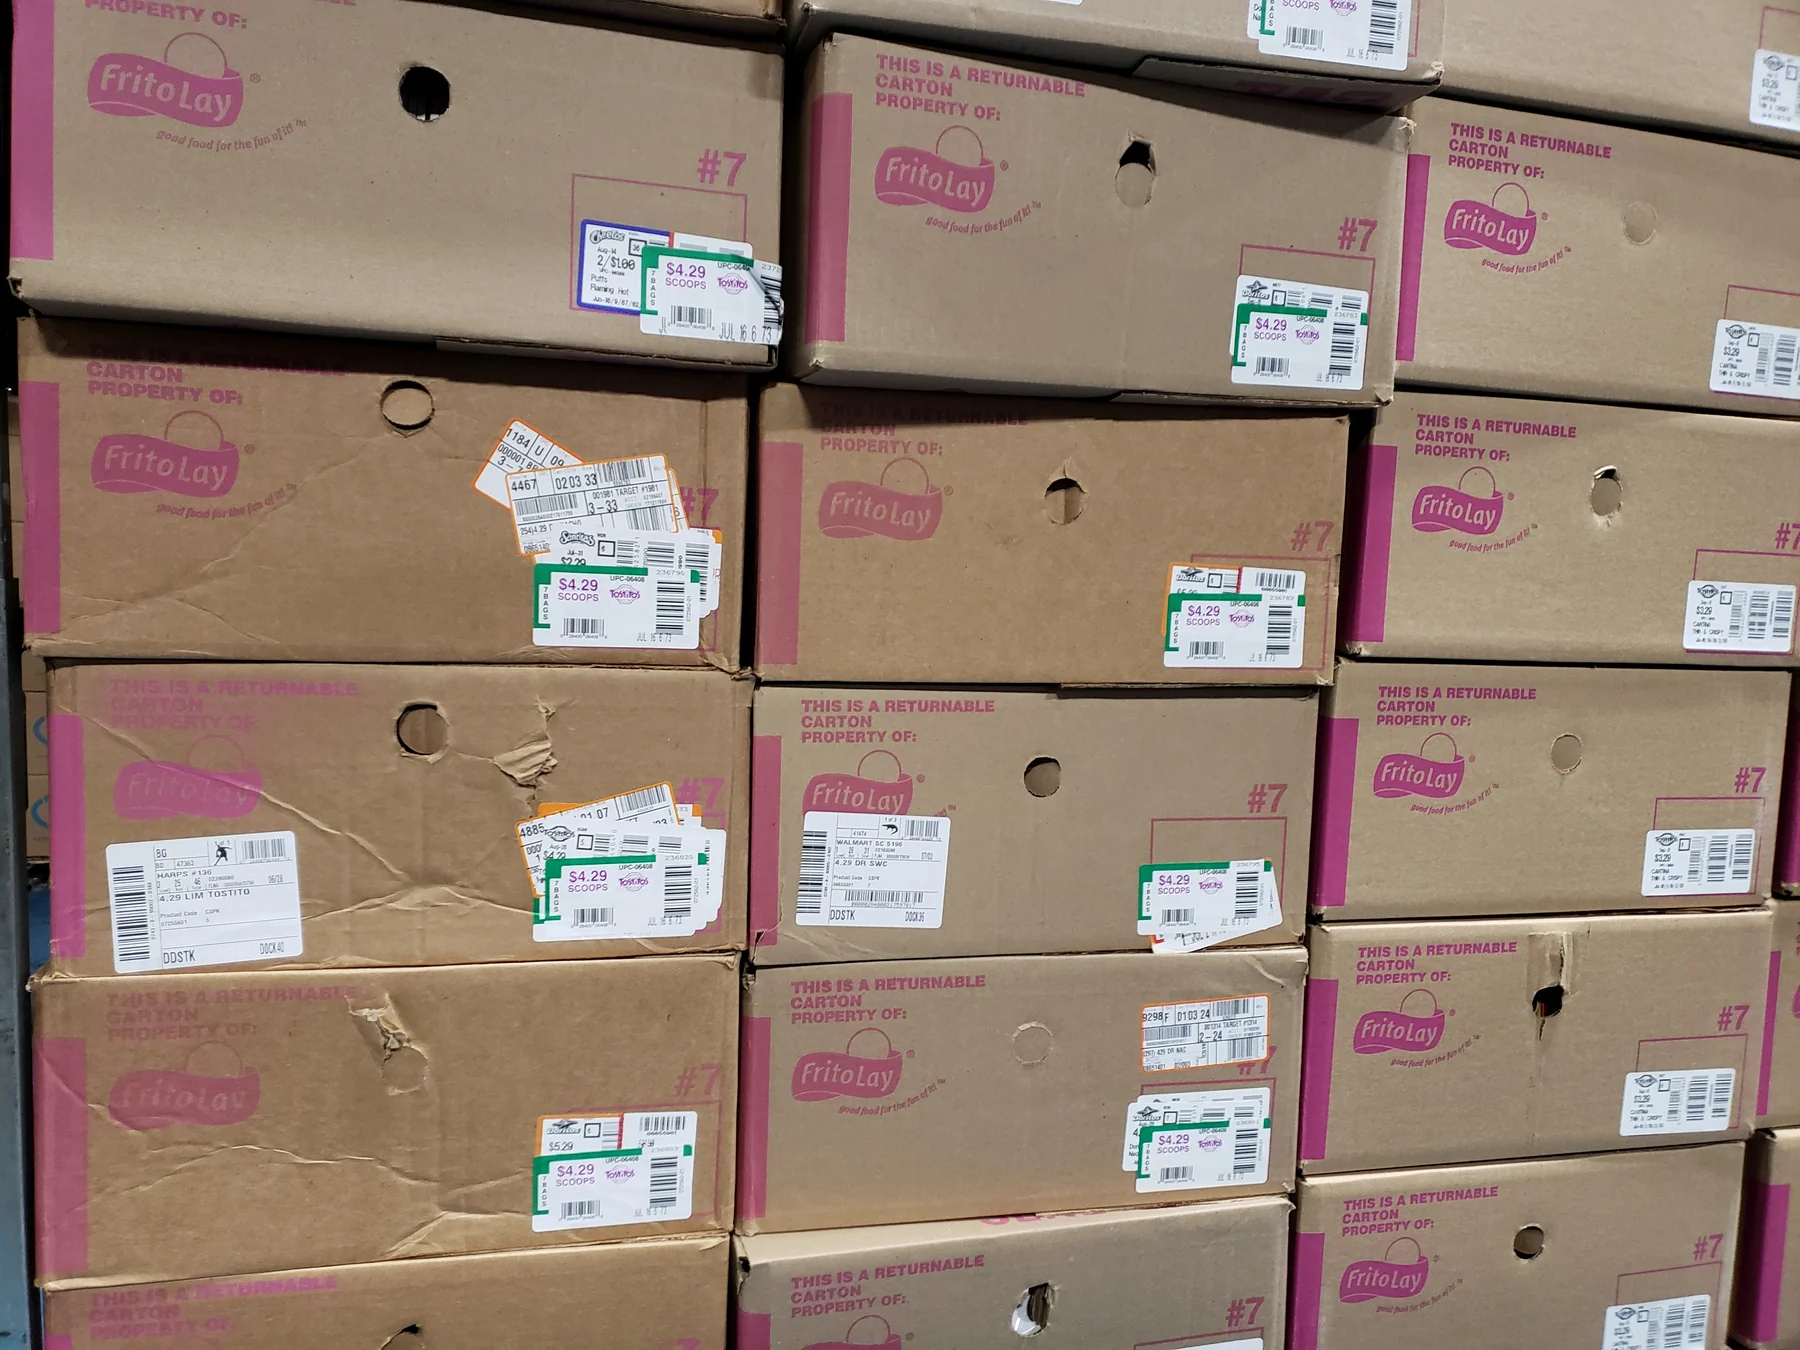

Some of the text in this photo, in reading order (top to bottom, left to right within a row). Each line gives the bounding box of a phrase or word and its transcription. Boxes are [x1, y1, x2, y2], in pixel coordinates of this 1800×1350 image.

[1283, 0, 1319, 10] SCOOPS
[84, 0, 247, 29] PROPERTY OF:
[876, 54, 1085, 97] THIS IS A RETURNABLE
[876, 73, 952, 96] CARTON
[876, 92, 1000, 120] PROPERTY OF:
[1451, 123, 1611, 158] THIS IS A RETURNABLE
[1449, 139, 1508, 159] CARTON
[697, 149, 747, 186] #7
[1449, 154, 1544, 179] PROPERTY OF:
[1338, 216, 1378, 252] #7
[666, 262, 706, 278] $4.29
[591, 275, 607, 283] Puffs
[665, 278, 706, 289] SCOOPS
[719, 323, 735, 341] JUL
[1256, 318, 1287, 331] $4.29
[1254, 332, 1286, 341] SCOOPS
[86, 361, 183, 383] CARTON
[88, 380, 203, 401] PROPERTY
[1417, 414, 1576, 438] THIS IS A RETURNABLE
[506, 428, 543, 456] 1184 U
[1416, 429, 1474, 444] CARTON
[820, 436, 943, 456] PROPERTY OF:
[1415, 444, 1510, 462] PROPERTY OF:
[511, 478, 537, 491] 4467
[616, 486, 639, 496] TARGET
[1291, 521, 1335, 551] #7
[1775, 523, 1800, 550] #7
[559, 578, 598, 591] $4.29
[558, 592, 599, 601] SCOOPS
[1187, 605, 1220, 617] $4.29
[1186, 618, 1220, 626] SCOOPS
[1379, 686, 1536, 700] THIS IS A RETURNABLE
[801, 700, 995, 713] THIS IS A RETURNABLE
[1377, 701, 1436, 712] CARTON
[801, 716, 872, 728] CARTON
[1377, 715, 1471, 726] PROPERTY OF:
[802, 731, 917, 743] PROPERTY OF:
[1734, 767, 1766, 793] #7
[1248, 784, 1288, 813] #7
[519, 823, 544, 838] 4885
[156, 849, 167, 858] BG
[157, 871, 188, 879] HARPS
[569, 870, 607, 883] $4.29
[1159, 874, 1190, 886] $4.29
[568, 883, 608, 892] SCOOPS
[1158, 887, 1190, 895] SCOOPS
[159, 889, 250, 902] 4.29 LIM TOSTITO
[830, 909, 855, 921] DDSTK
[163, 950, 195, 964] DDSTK
[791, 975, 986, 994] THIS IS A RETURNABLE
[791, 995, 863, 1009] CARTON
[791, 1008, 907, 1025] PROPERTY OF:
[1142, 1012, 1169, 1022] 9298 F
[1718, 1005, 1750, 1031] #7
[1223, 1021, 1241, 1029] TARGET
[674, 1063, 722, 1096] #7
[1158, 1134, 1190, 1145] $4.29
[1157, 1146, 1190, 1154] SCOOPS
[557, 1164, 594, 1177] $4.29
[556, 1177, 595, 1187] SCOOPS
[1344, 1186, 1498, 1211] THIS IS A RETURNABLE
[1342, 1209, 1399, 1224] CARTON
[1342, 1219, 1434, 1237] PROPERTY OF:
[1693, 1234, 1723, 1260] #7
[791, 1255, 985, 1289] THIS IS A RETURNABLE
[791, 1285, 861, 1304] CARTON
[791, 1294, 906, 1318] PROPERTY OF:
[1226, 1296, 1264, 1327] #7
